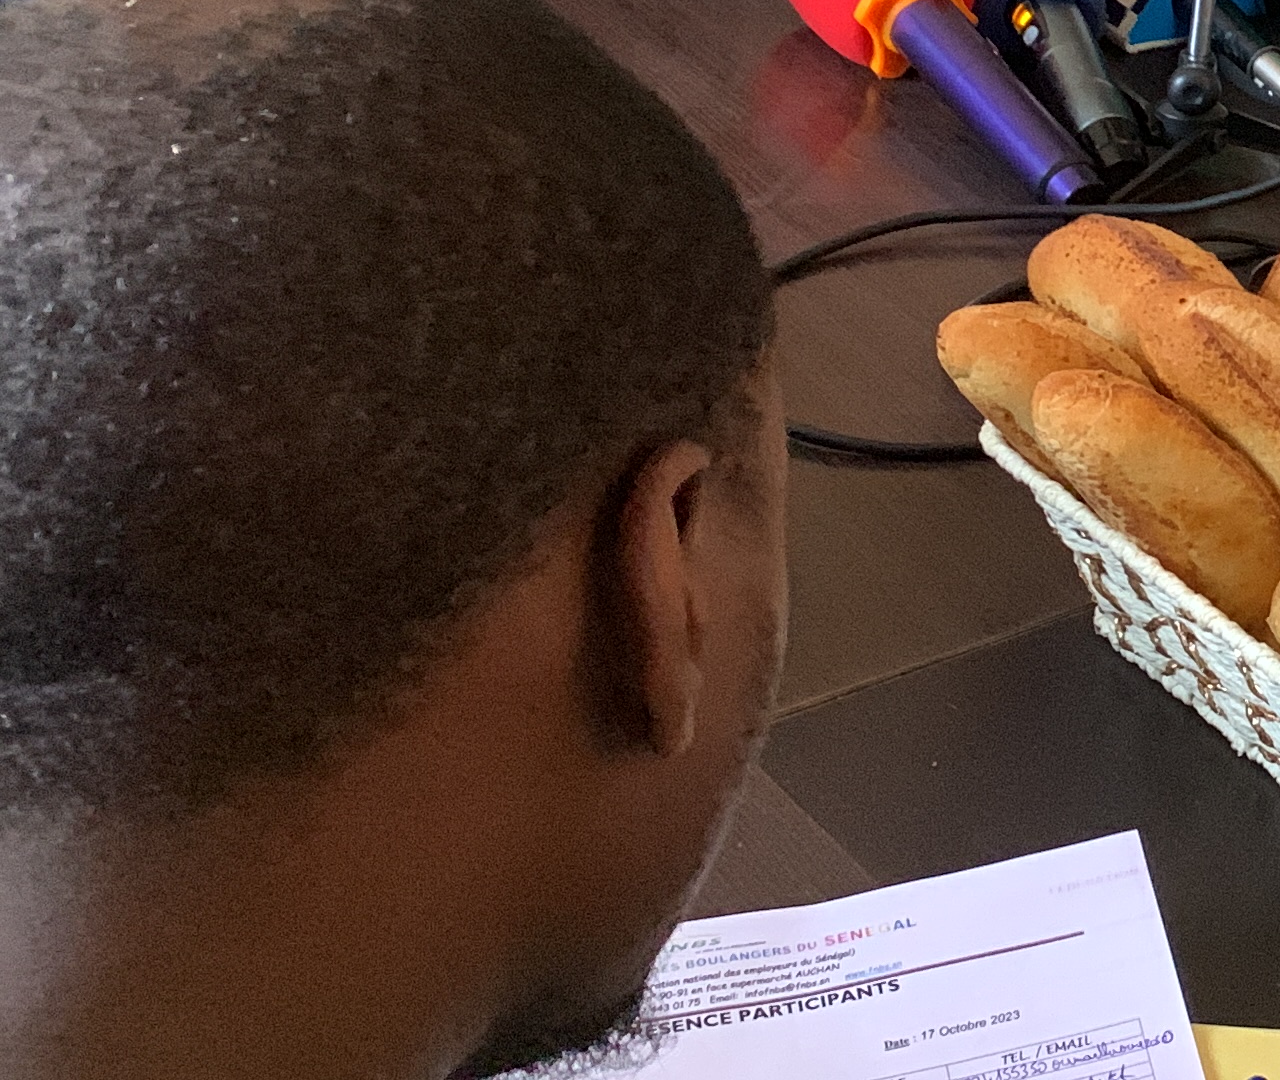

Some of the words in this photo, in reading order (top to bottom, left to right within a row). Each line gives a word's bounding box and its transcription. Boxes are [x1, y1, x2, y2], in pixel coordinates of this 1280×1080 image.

[685, 944, 792, 969] BOULANGERS
[797, 940, 818, 953] DU
[724, 968, 742, 979] des
[800, 958, 813, 967] du
[706, 982, 728, 994] face
[796, 962, 841, 979] AUCHAN
[739, 978, 901, 1022] PARTICIPANTS
[921, 1028, 936, 1041] 17
[939, 1019, 988, 1037] Octobre
[990, 1009, 1021, 1026] 2023
[1046, 1034, 1092, 1055] EMAIL
